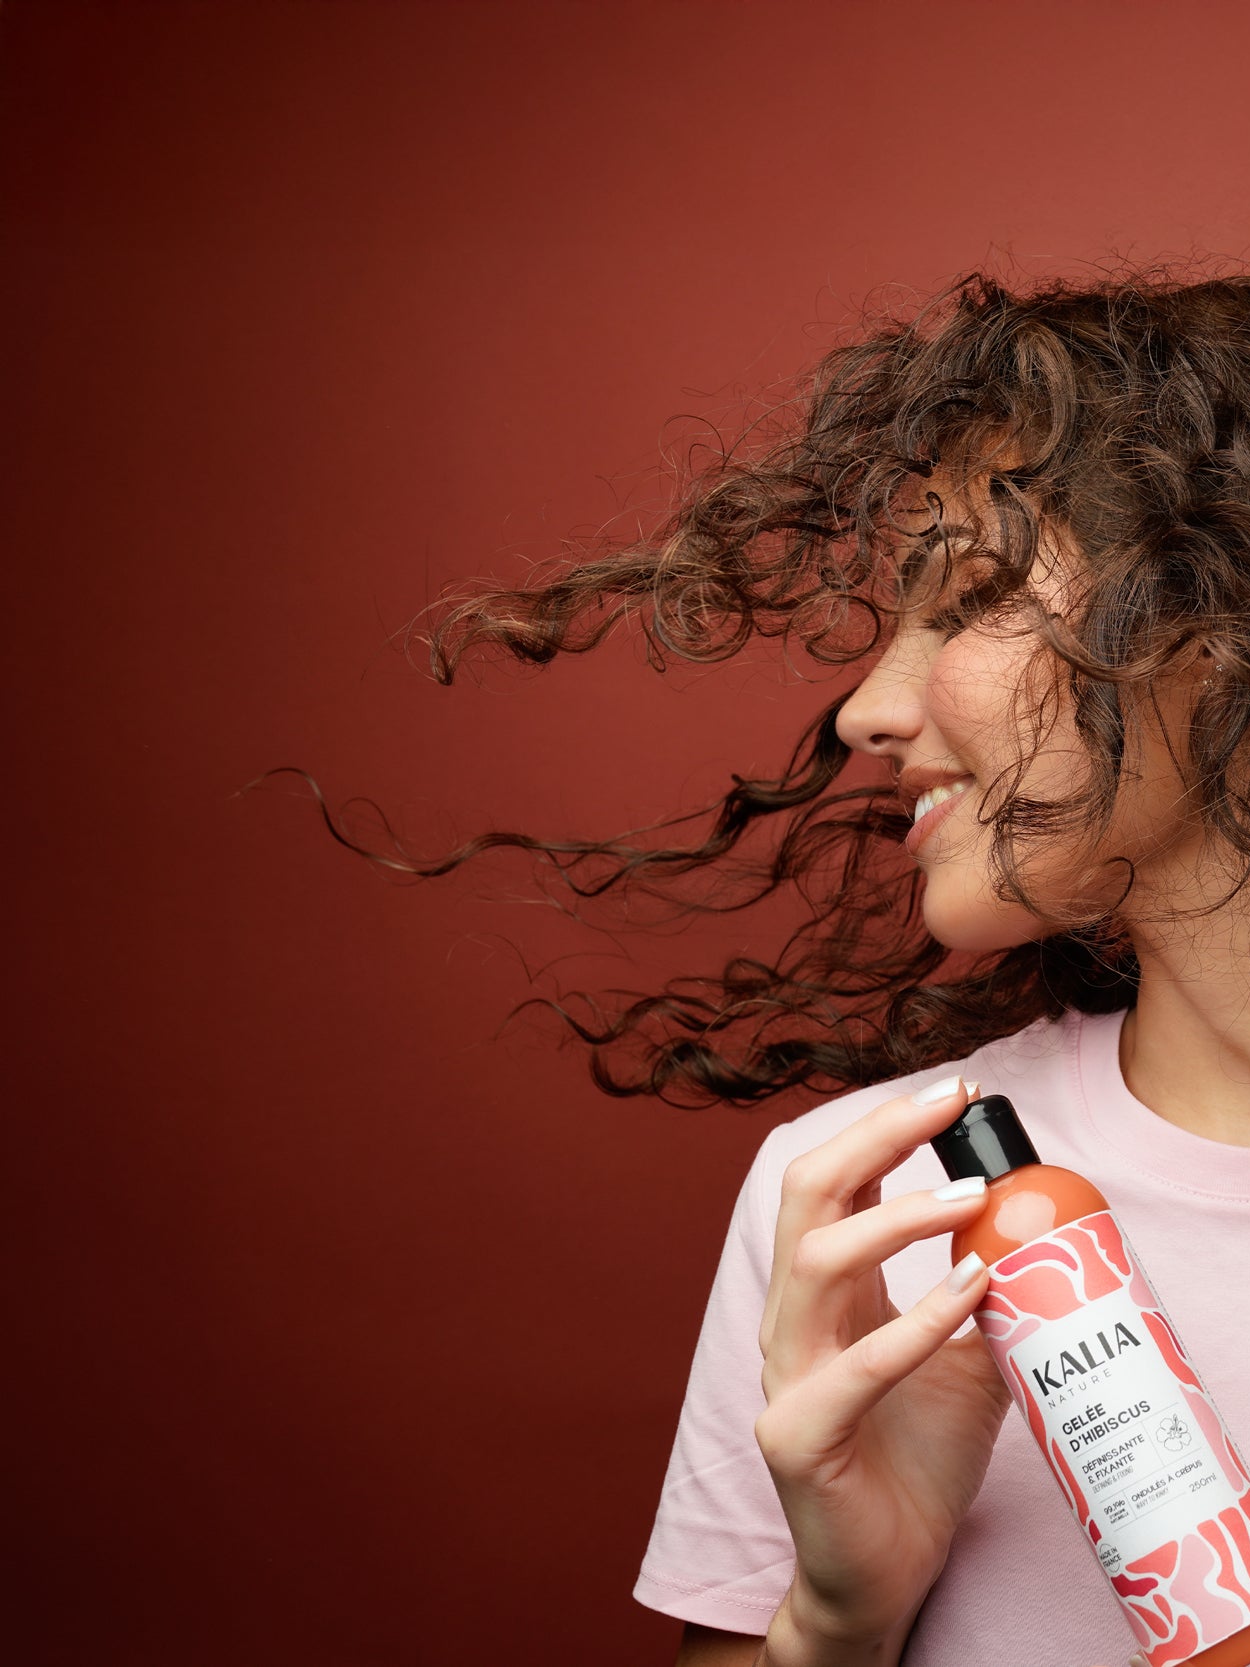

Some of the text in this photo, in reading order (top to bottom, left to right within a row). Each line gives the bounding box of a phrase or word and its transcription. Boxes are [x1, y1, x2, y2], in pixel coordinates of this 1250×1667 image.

[1032, 1322, 1141, 1396] KALIA
[1048, 1368, 1111, 1409] NATURE
[1062, 1403, 1106, 1435] GELÉE
[1069, 1400, 1150, 1453] D'HIBISCUS
[1082, 1434, 1145, 1474] DÉFINISSANTE
[1088, 1452, 1135, 1485] & FIXANTE
[1131, 1479, 1166, 1502] ONDULÉS
[1175, 1459, 1202, 1478] CRÉPUS
[1189, 1473, 1217, 1492] 250ml
[1100, 1546, 1118, 1560] MADE IN
[1103, 1554, 1122, 1568] FRANCE
